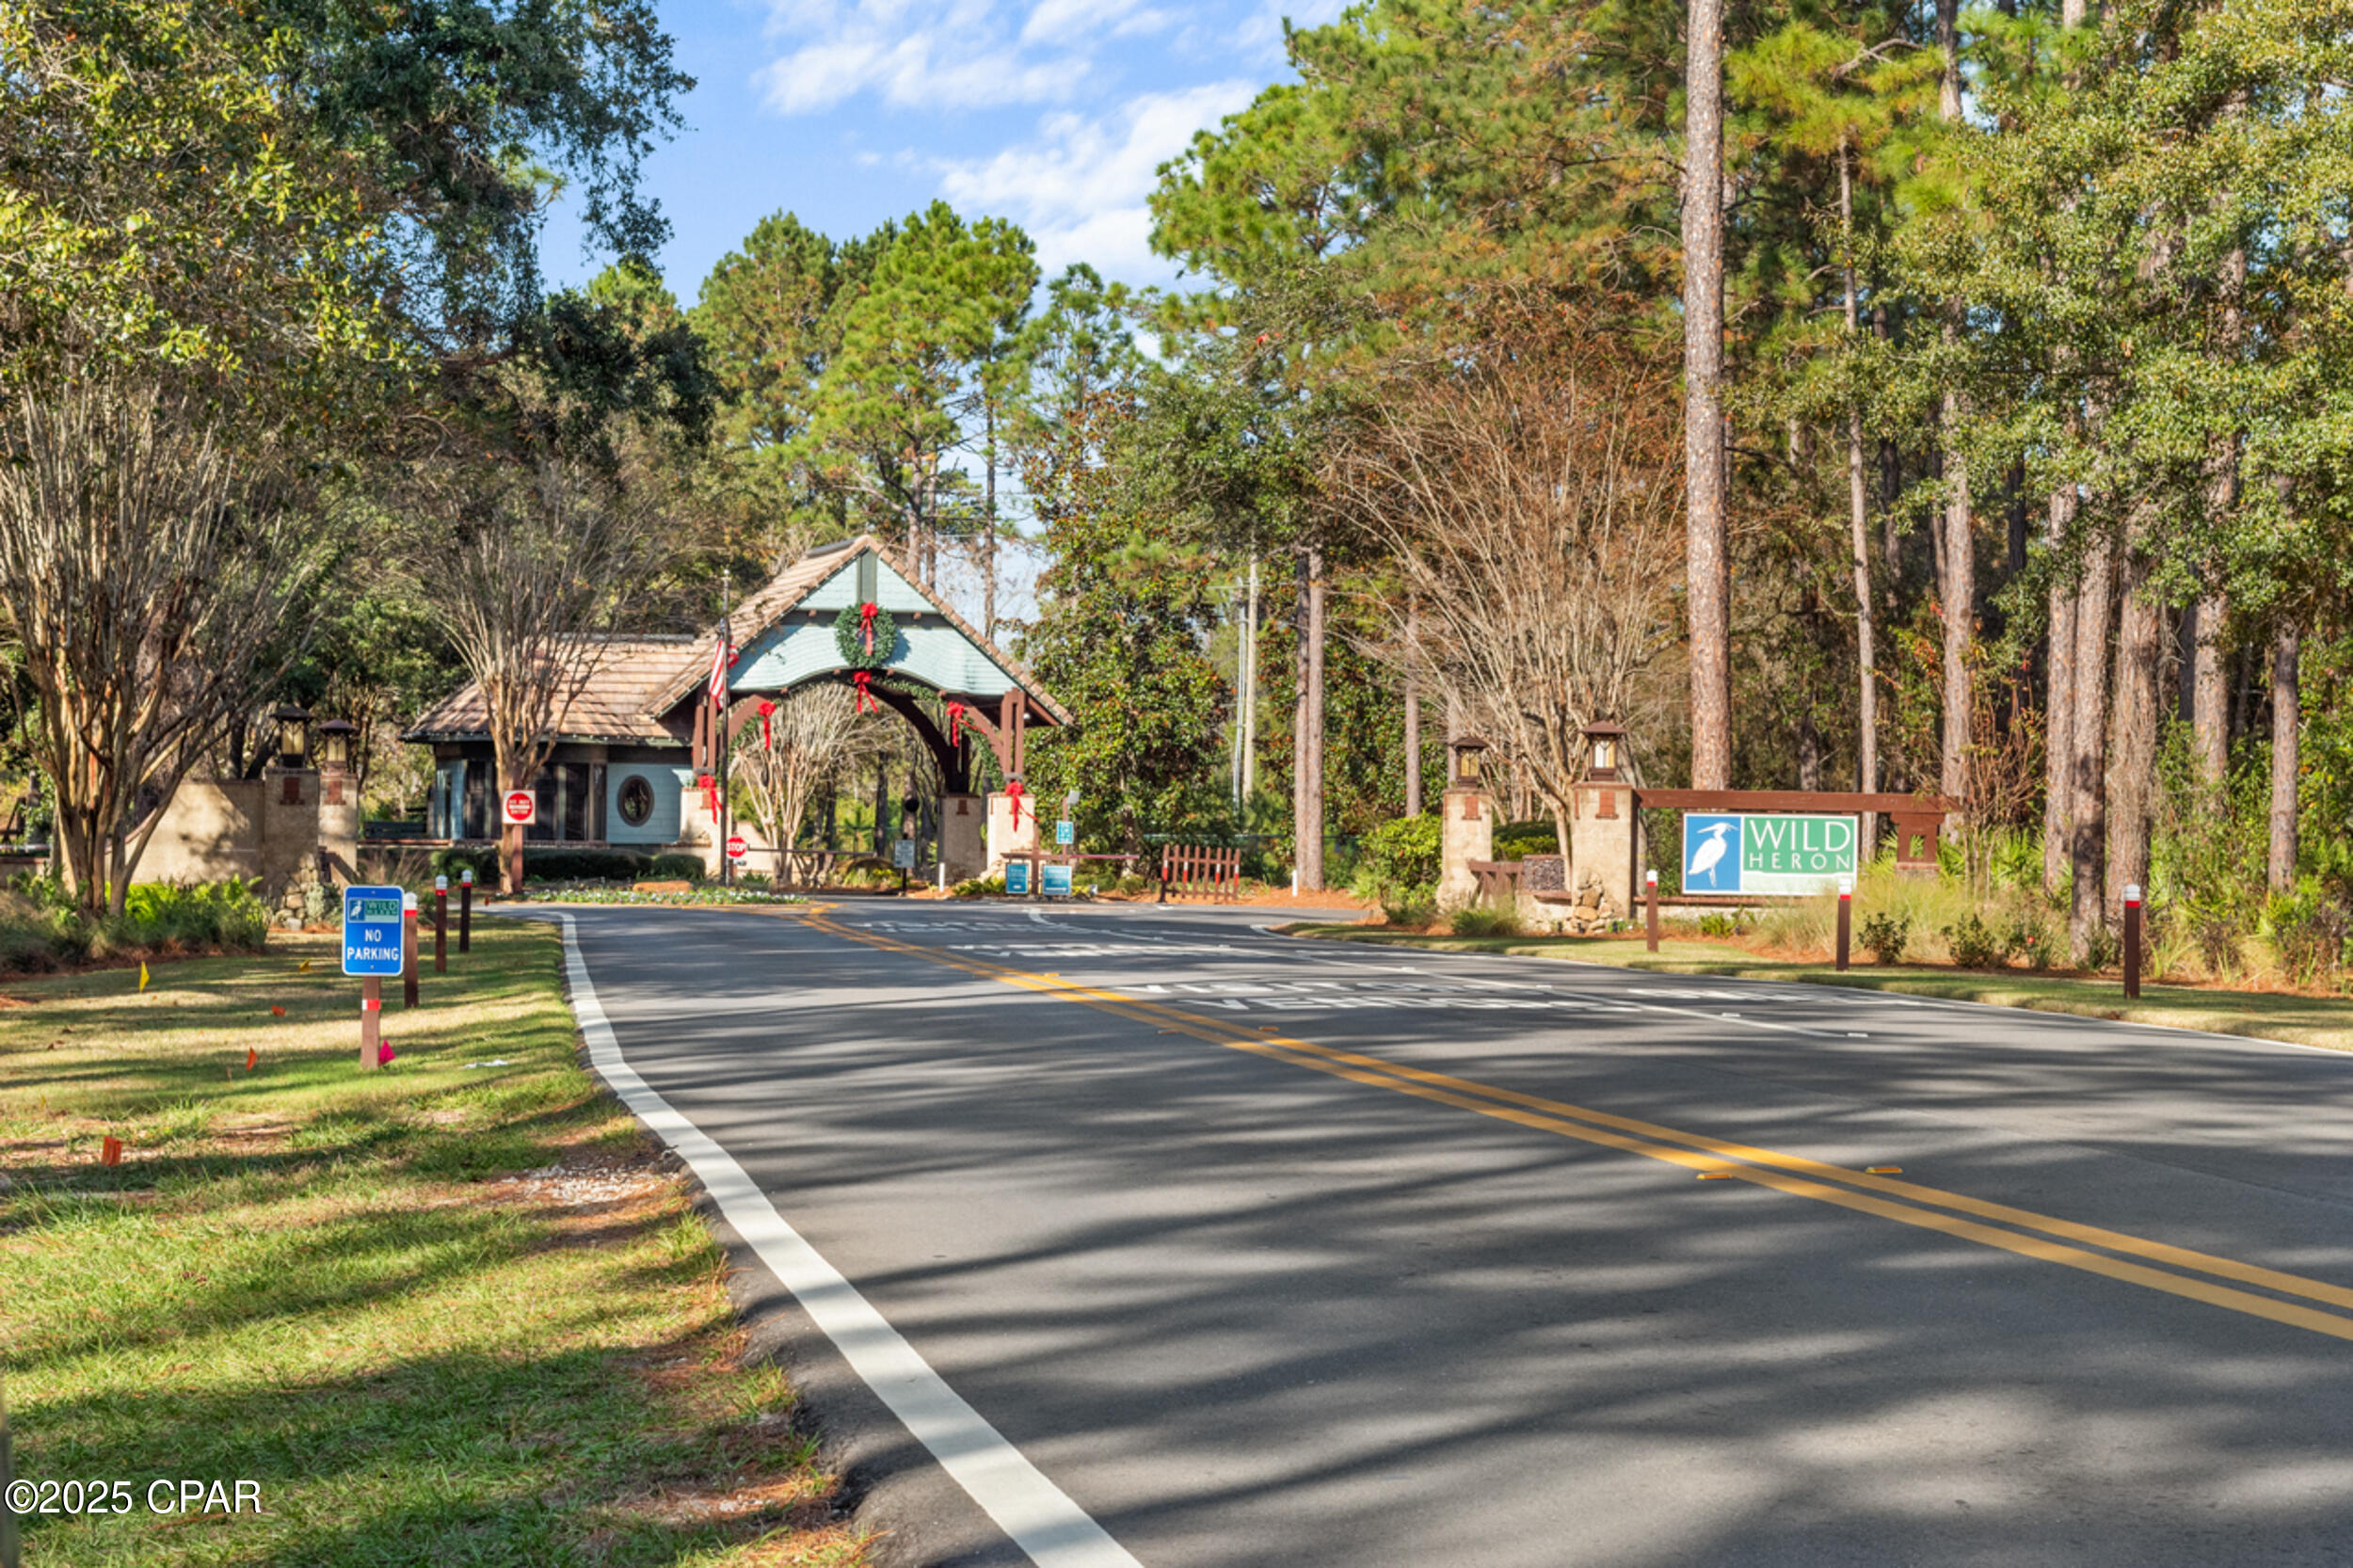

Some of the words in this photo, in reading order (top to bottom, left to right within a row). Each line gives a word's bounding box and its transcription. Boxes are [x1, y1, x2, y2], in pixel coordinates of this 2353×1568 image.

[1749, 820, 1850, 852] WILD
[727, 842, 746, 853] STOP
[1749, 853, 1850, 870] HERON
[364, 929, 382, 942] NO
[346, 948, 399, 960] PARKING
